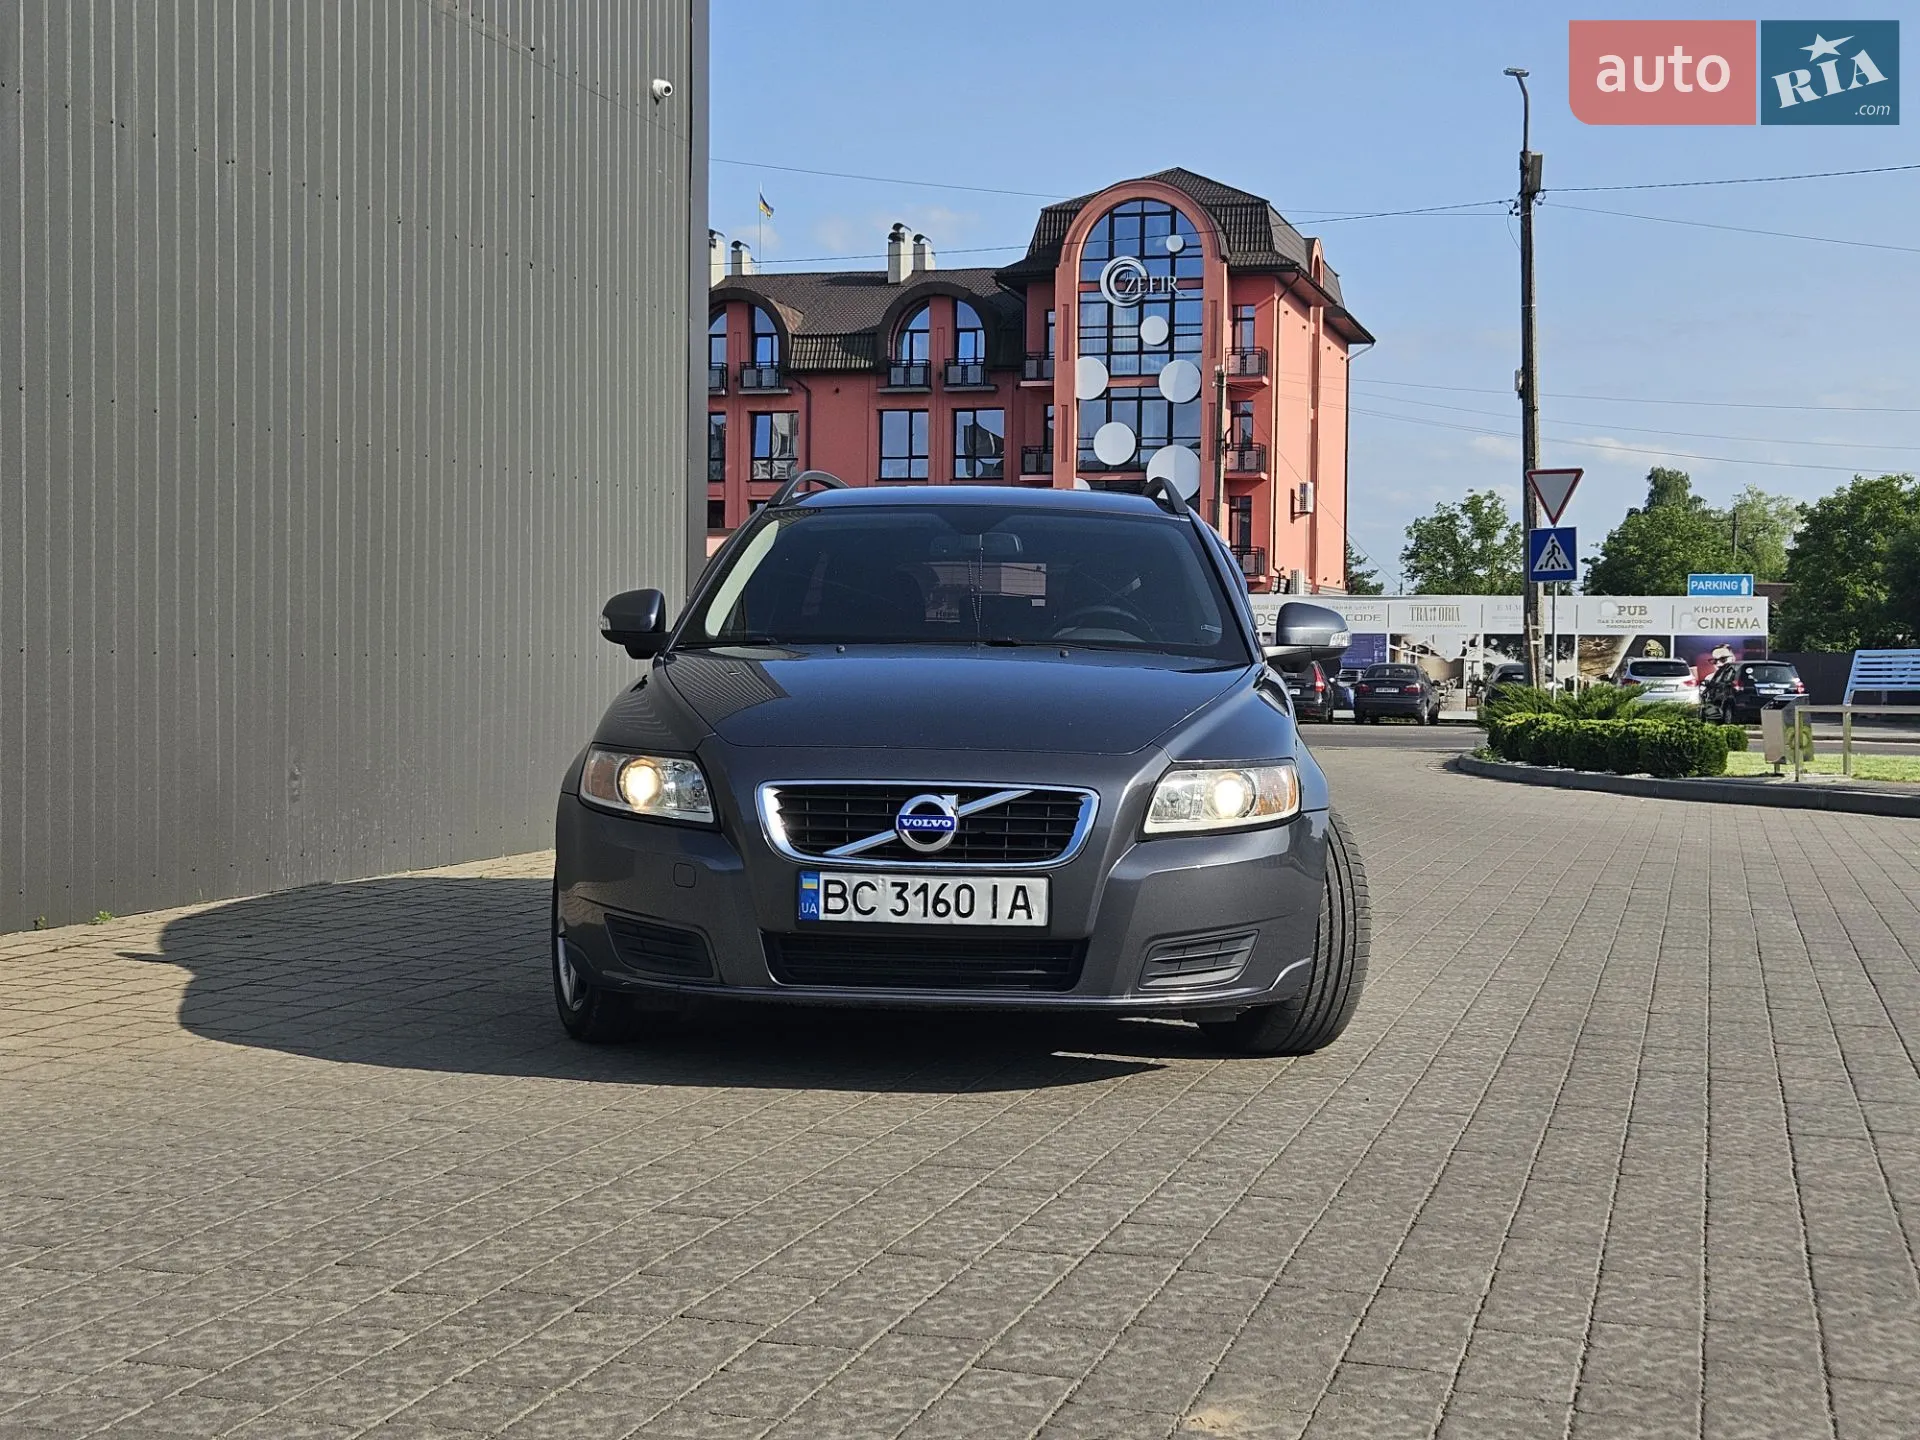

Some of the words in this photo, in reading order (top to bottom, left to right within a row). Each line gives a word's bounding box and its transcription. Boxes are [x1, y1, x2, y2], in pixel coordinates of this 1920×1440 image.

[1125, 275, 1181, 295] ZEFIR
[1691, 580, 1738, 590] PARKING
[1617, 605, 1648, 616] PUB
[1693, 606, 1753, 614] КІНОТЕАТР
[1345, 613, 1382, 622] CODE
[1697, 617, 1761, 630] CINEMA
[901, 818, 953, 829] VOLVO
[823, 879, 877, 916] BC
[889, 882, 976, 919] 3160
[990, 884, 1034, 920] IA
[801, 902, 818, 915] UA
